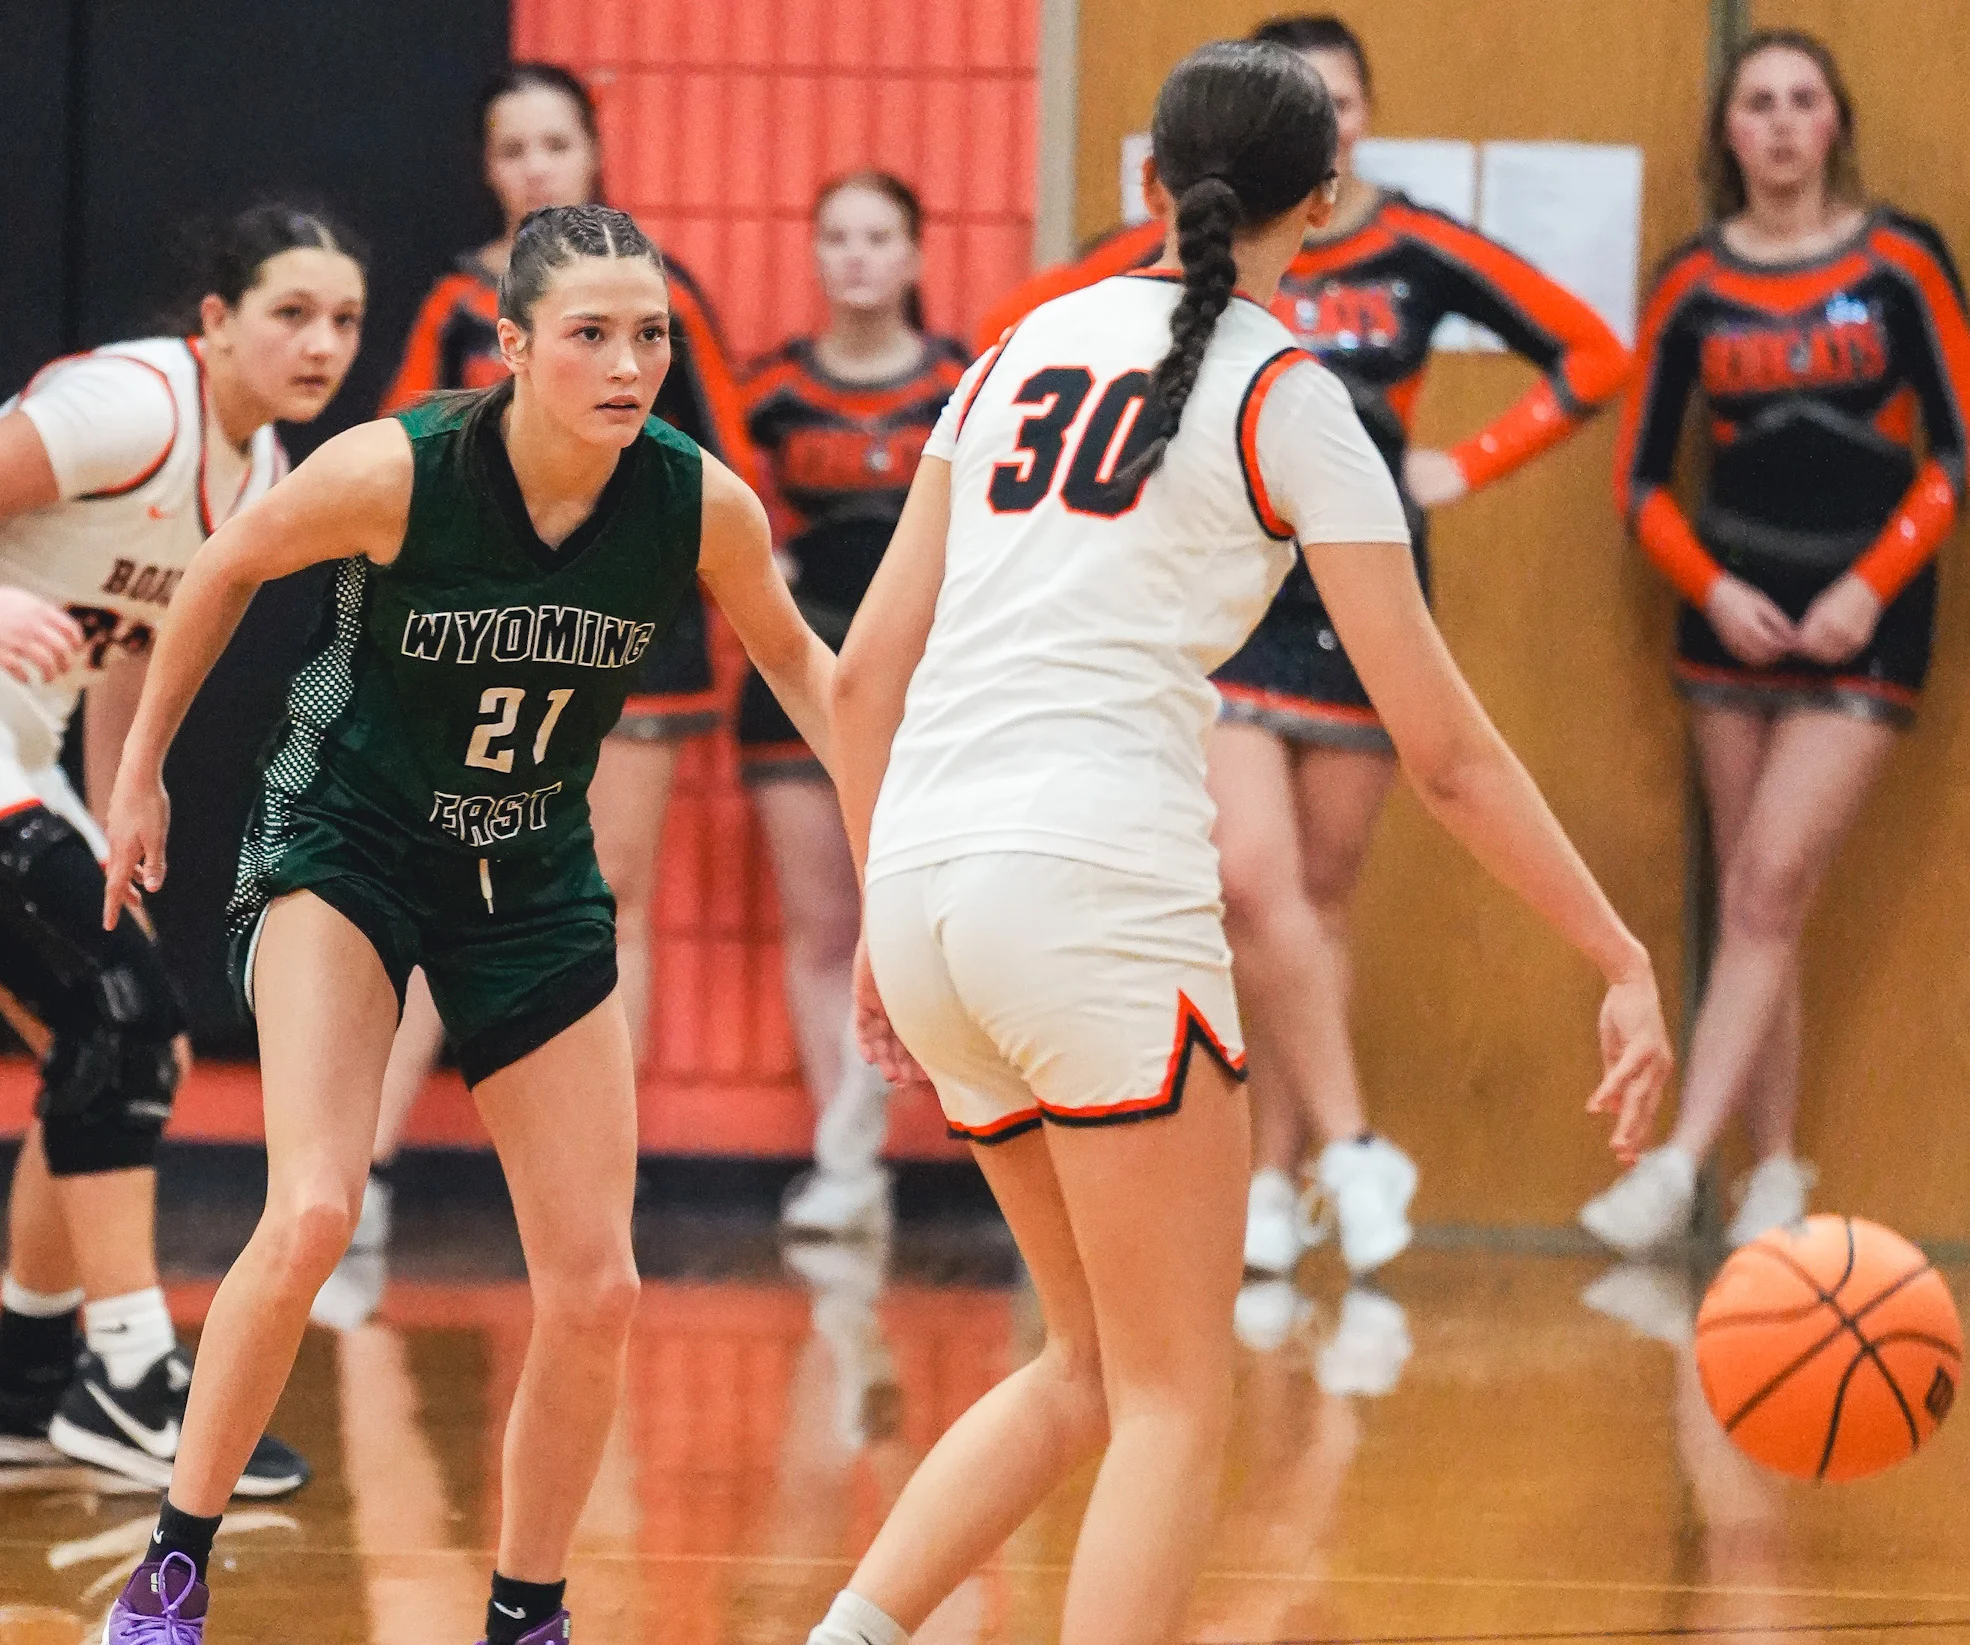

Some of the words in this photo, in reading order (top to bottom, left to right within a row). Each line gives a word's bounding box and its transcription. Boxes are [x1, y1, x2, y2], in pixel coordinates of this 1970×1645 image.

[986, 365, 1158, 521] 30
[400, 605, 656, 669] WYOMING
[464, 687, 576, 774] 21
[428, 780, 563, 848] EAST
